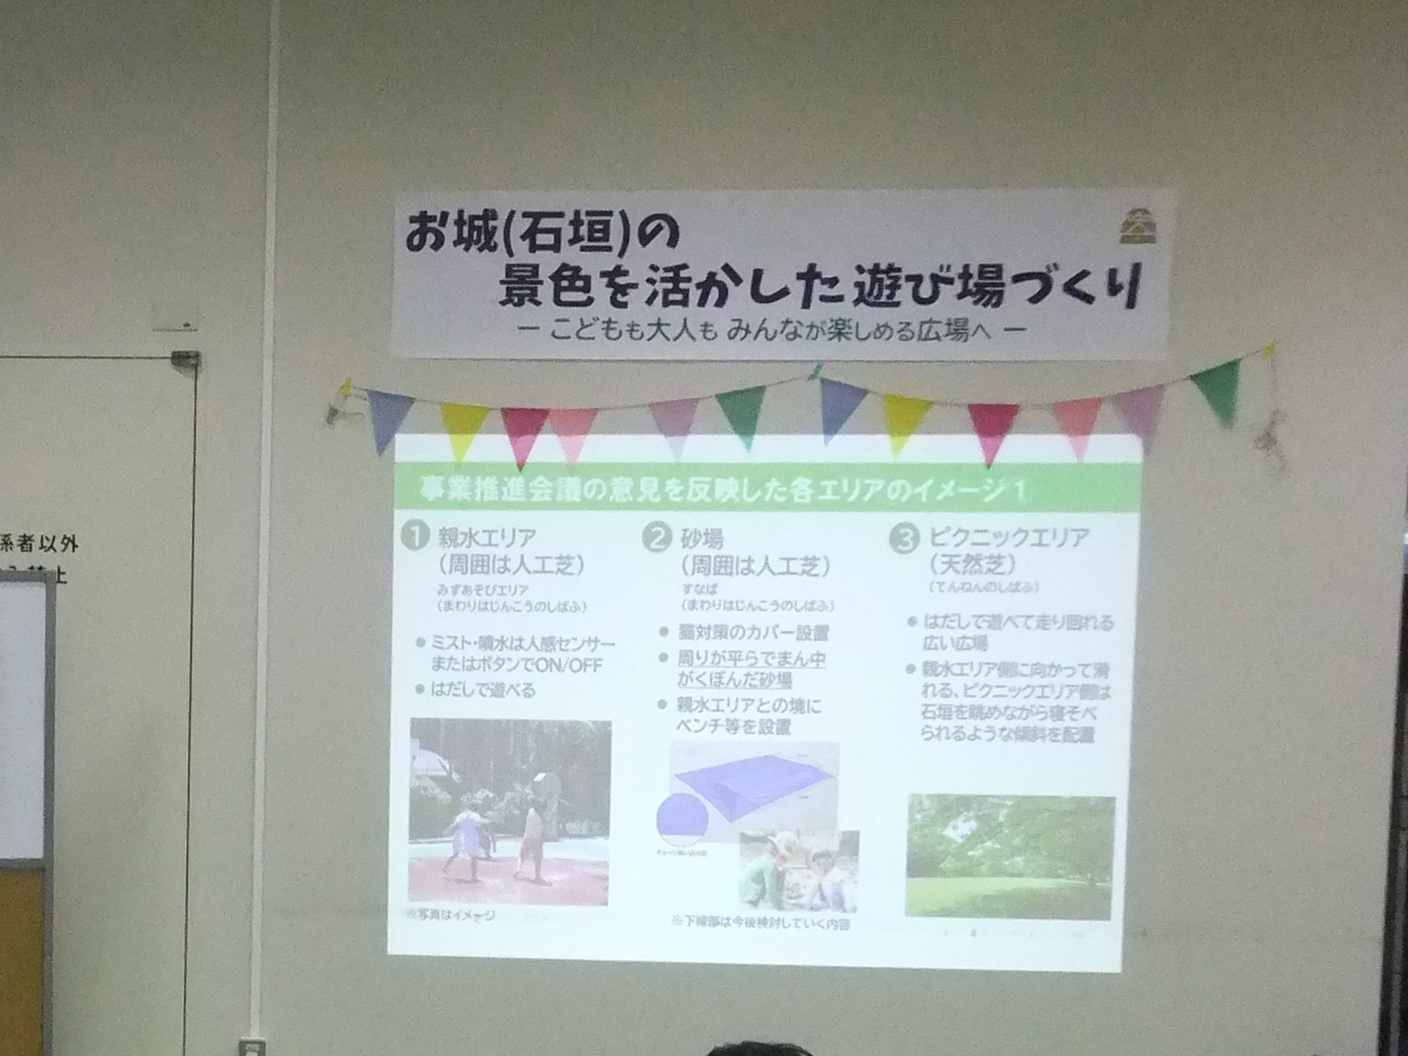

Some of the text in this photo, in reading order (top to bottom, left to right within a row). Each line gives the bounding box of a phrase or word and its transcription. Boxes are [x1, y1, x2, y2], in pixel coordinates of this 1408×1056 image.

[406, 208, 680, 258] お城(石垣)の
[498, 262, 1142, 309] 景色を活かした遊び場づくり
[438, 527, 536, 548] 親水エリア
[680, 528, 724, 549] 砂場
[930, 526, 1090, 548] ピクニックエリア
[922, 634, 988, 651] 広い広場
[678, 649, 827, 668] 周りが平らでまん中
[677, 670, 793, 688] がくぼんだ砂場
[431, 681, 536, 698] はだしで遊べる
[676, 718, 791, 735] ベンチ等を設置
